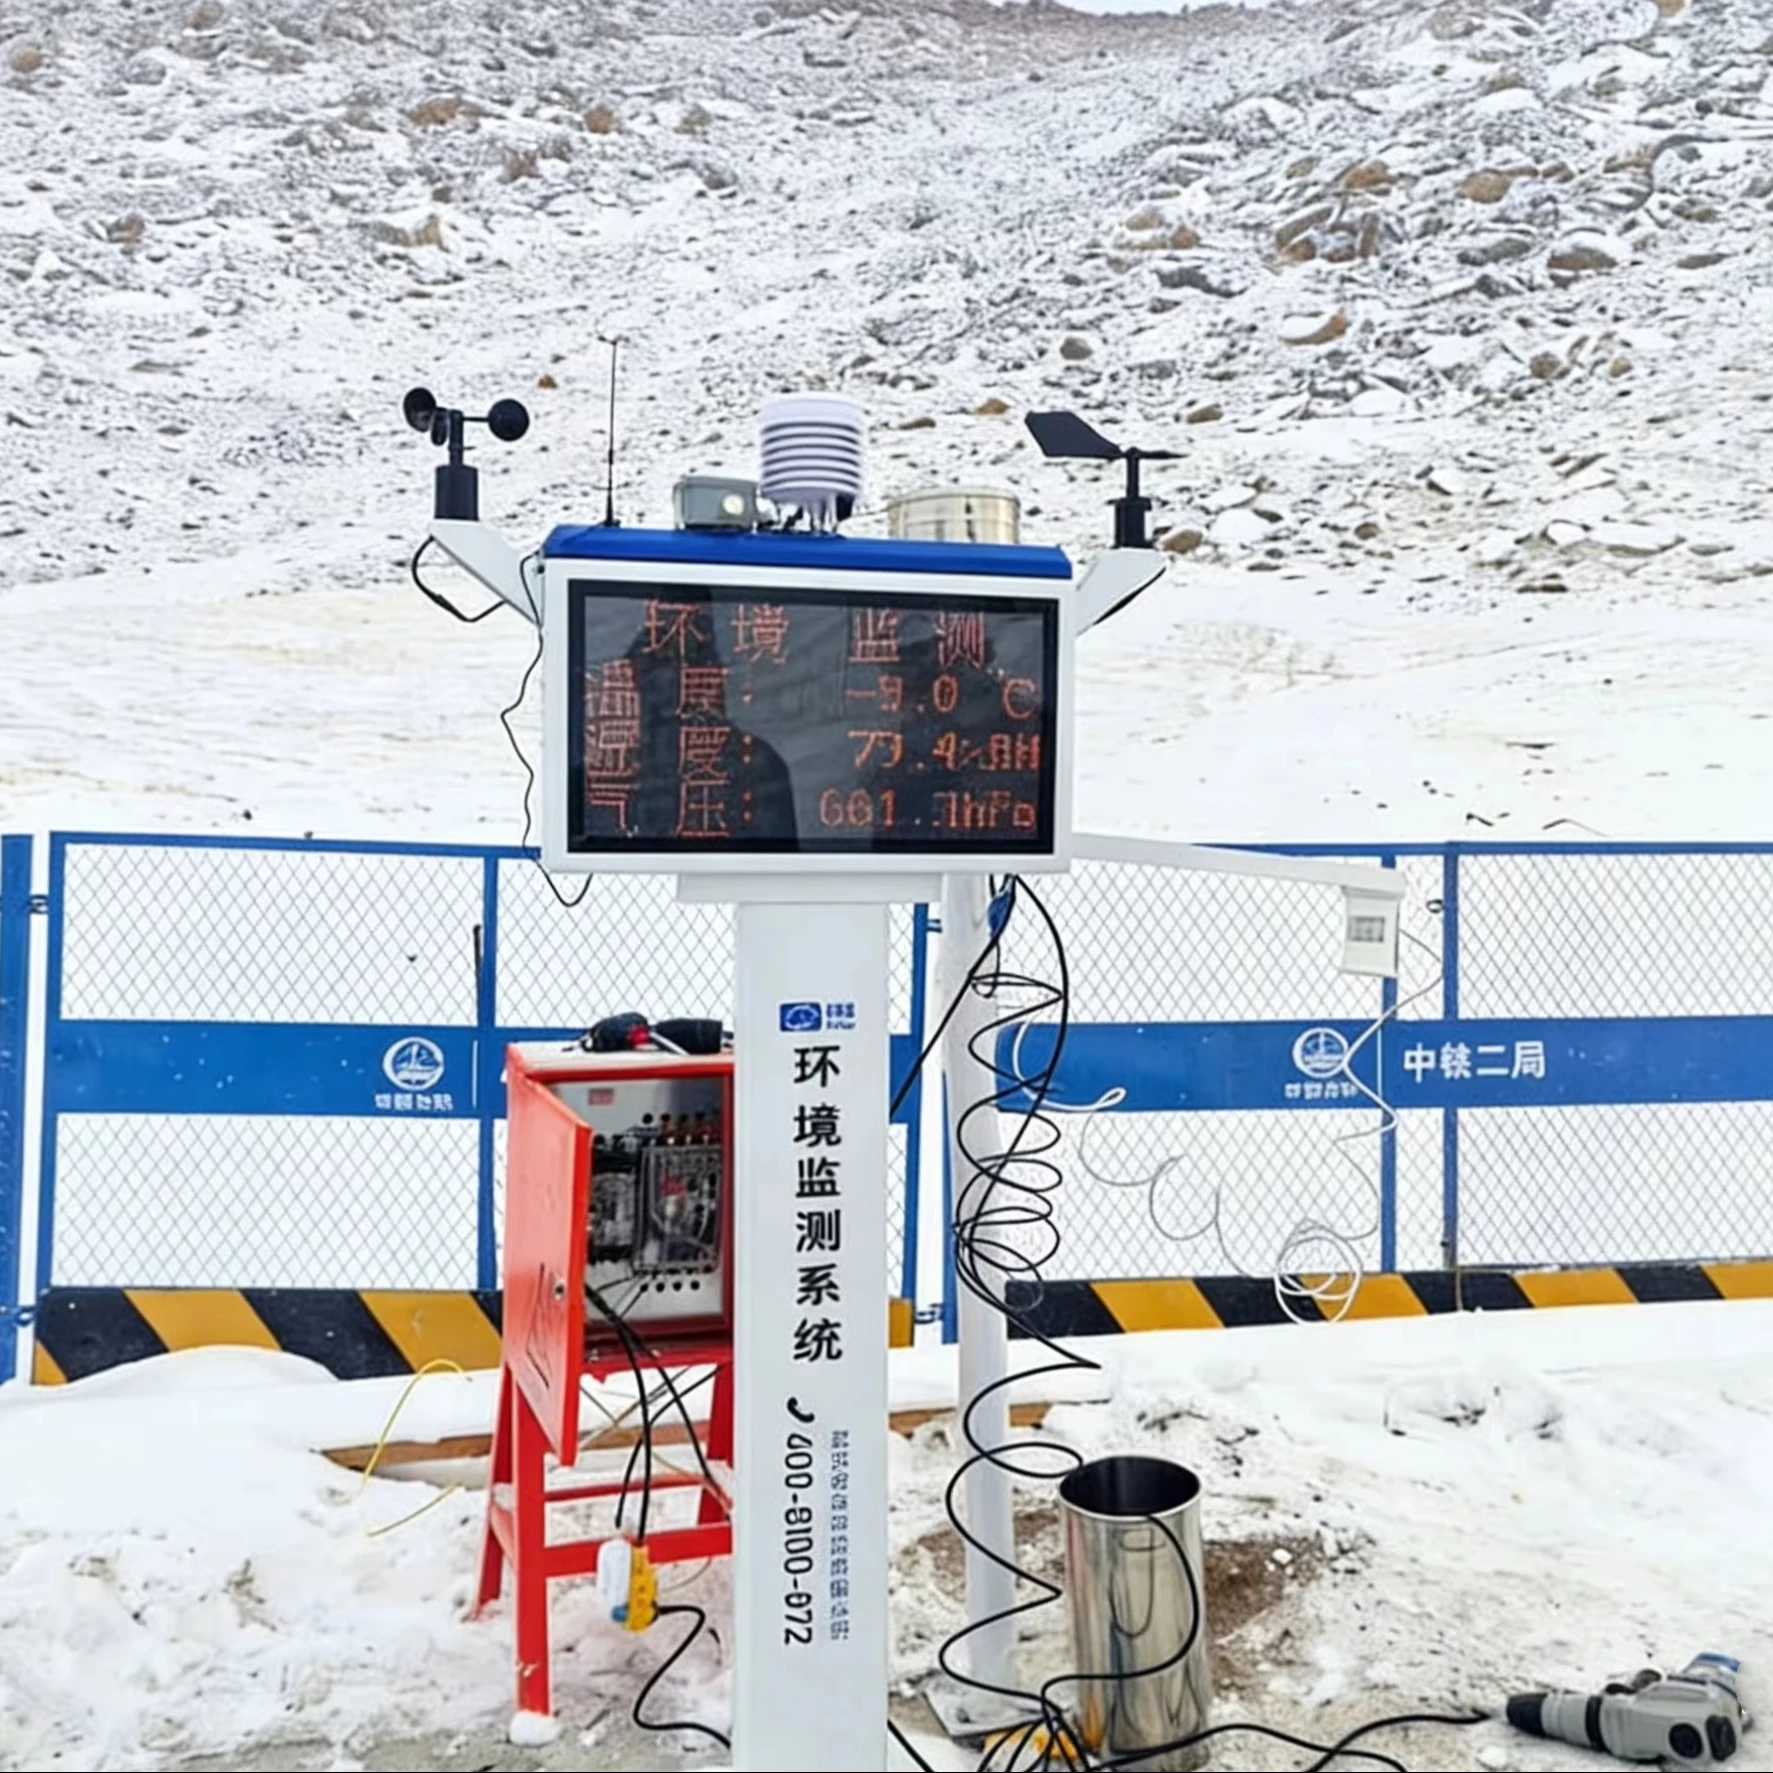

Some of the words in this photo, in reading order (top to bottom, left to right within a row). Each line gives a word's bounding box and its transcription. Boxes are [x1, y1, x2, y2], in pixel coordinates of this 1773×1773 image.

[642, 599, 988, 666] 环境监测
[793, 1045, 842, 1362] 环境监测系统
